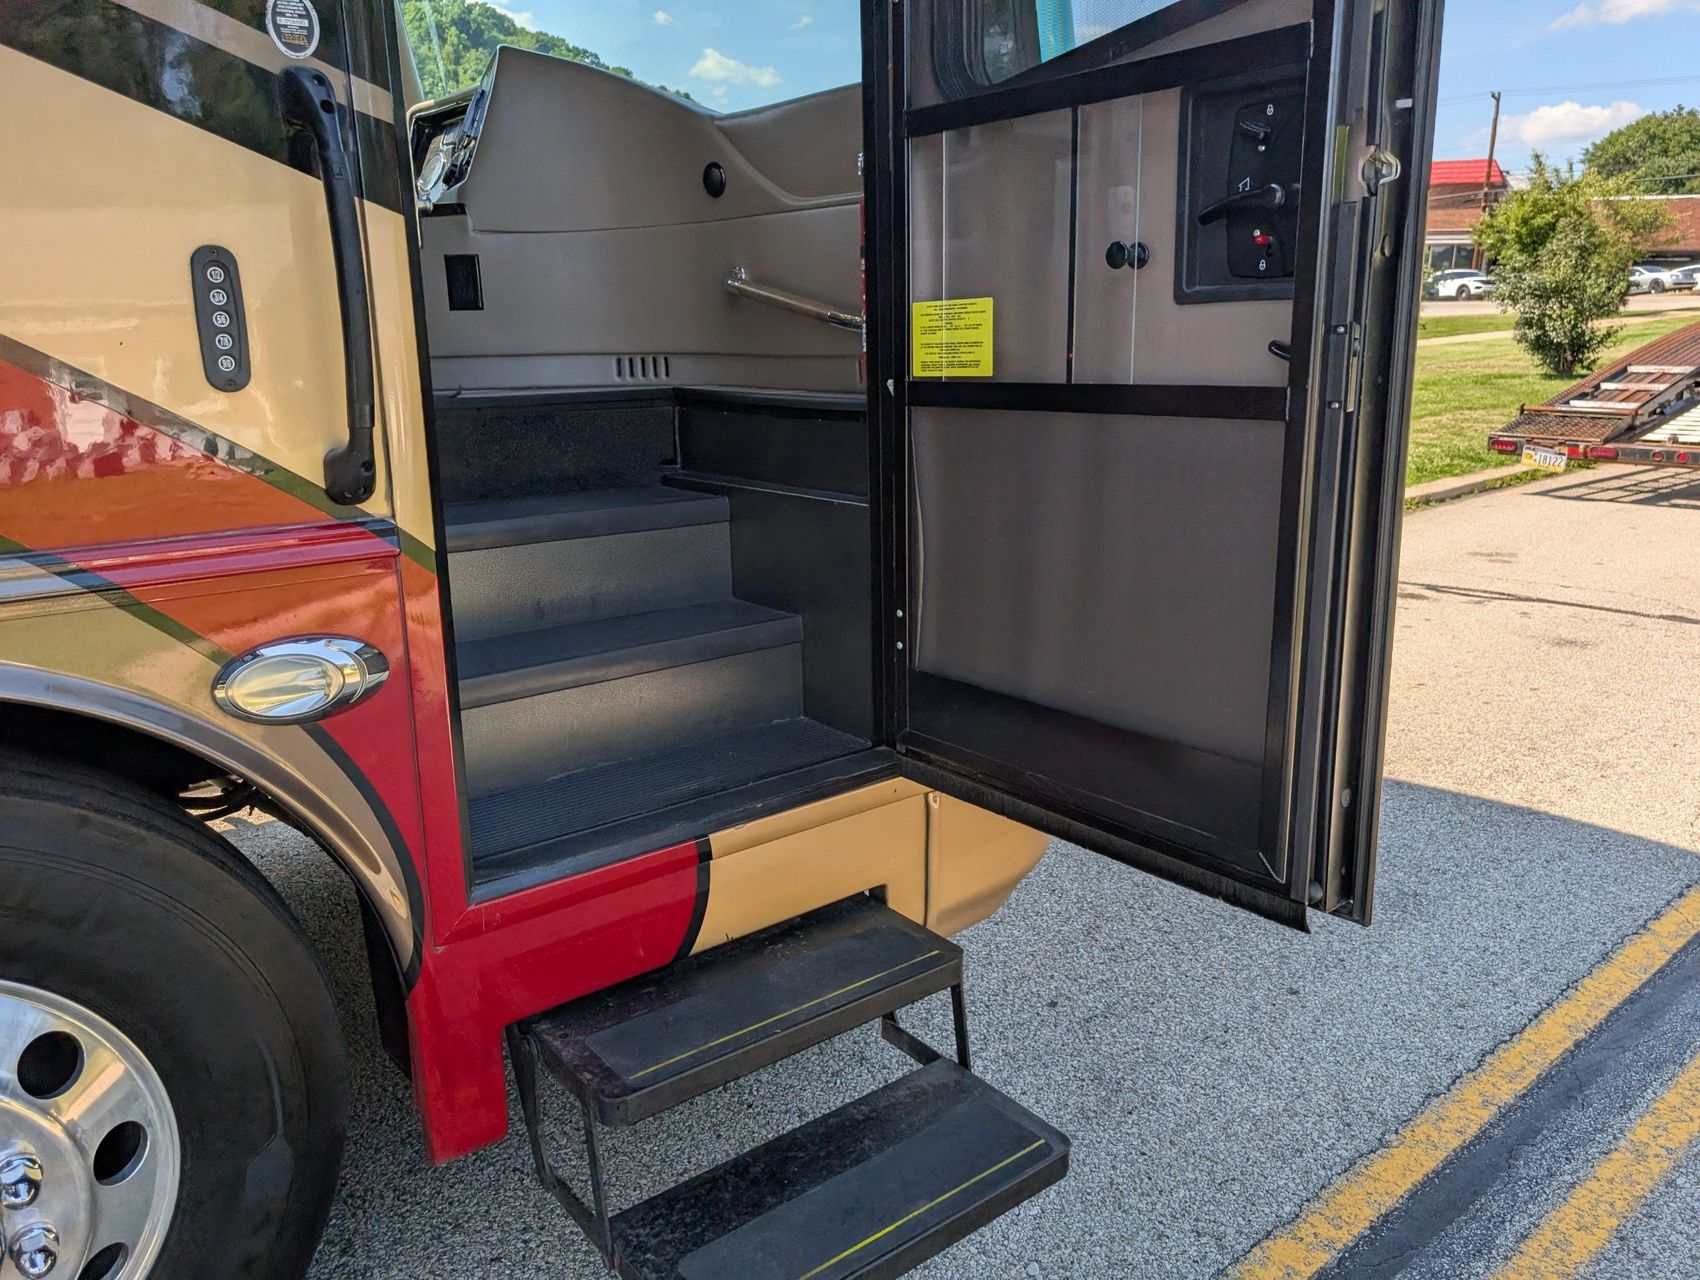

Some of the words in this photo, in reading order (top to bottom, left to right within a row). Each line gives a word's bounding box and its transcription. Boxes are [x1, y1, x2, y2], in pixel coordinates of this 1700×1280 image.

[211, 270, 221, 279] 1/2
[214, 292, 223, 302] 3/4
[217, 314, 226, 324] 5/6
[219, 337, 229, 346] 7/8
[222, 359, 231, 368] 9/0
[1538, 454, 1563, 467] 18122
